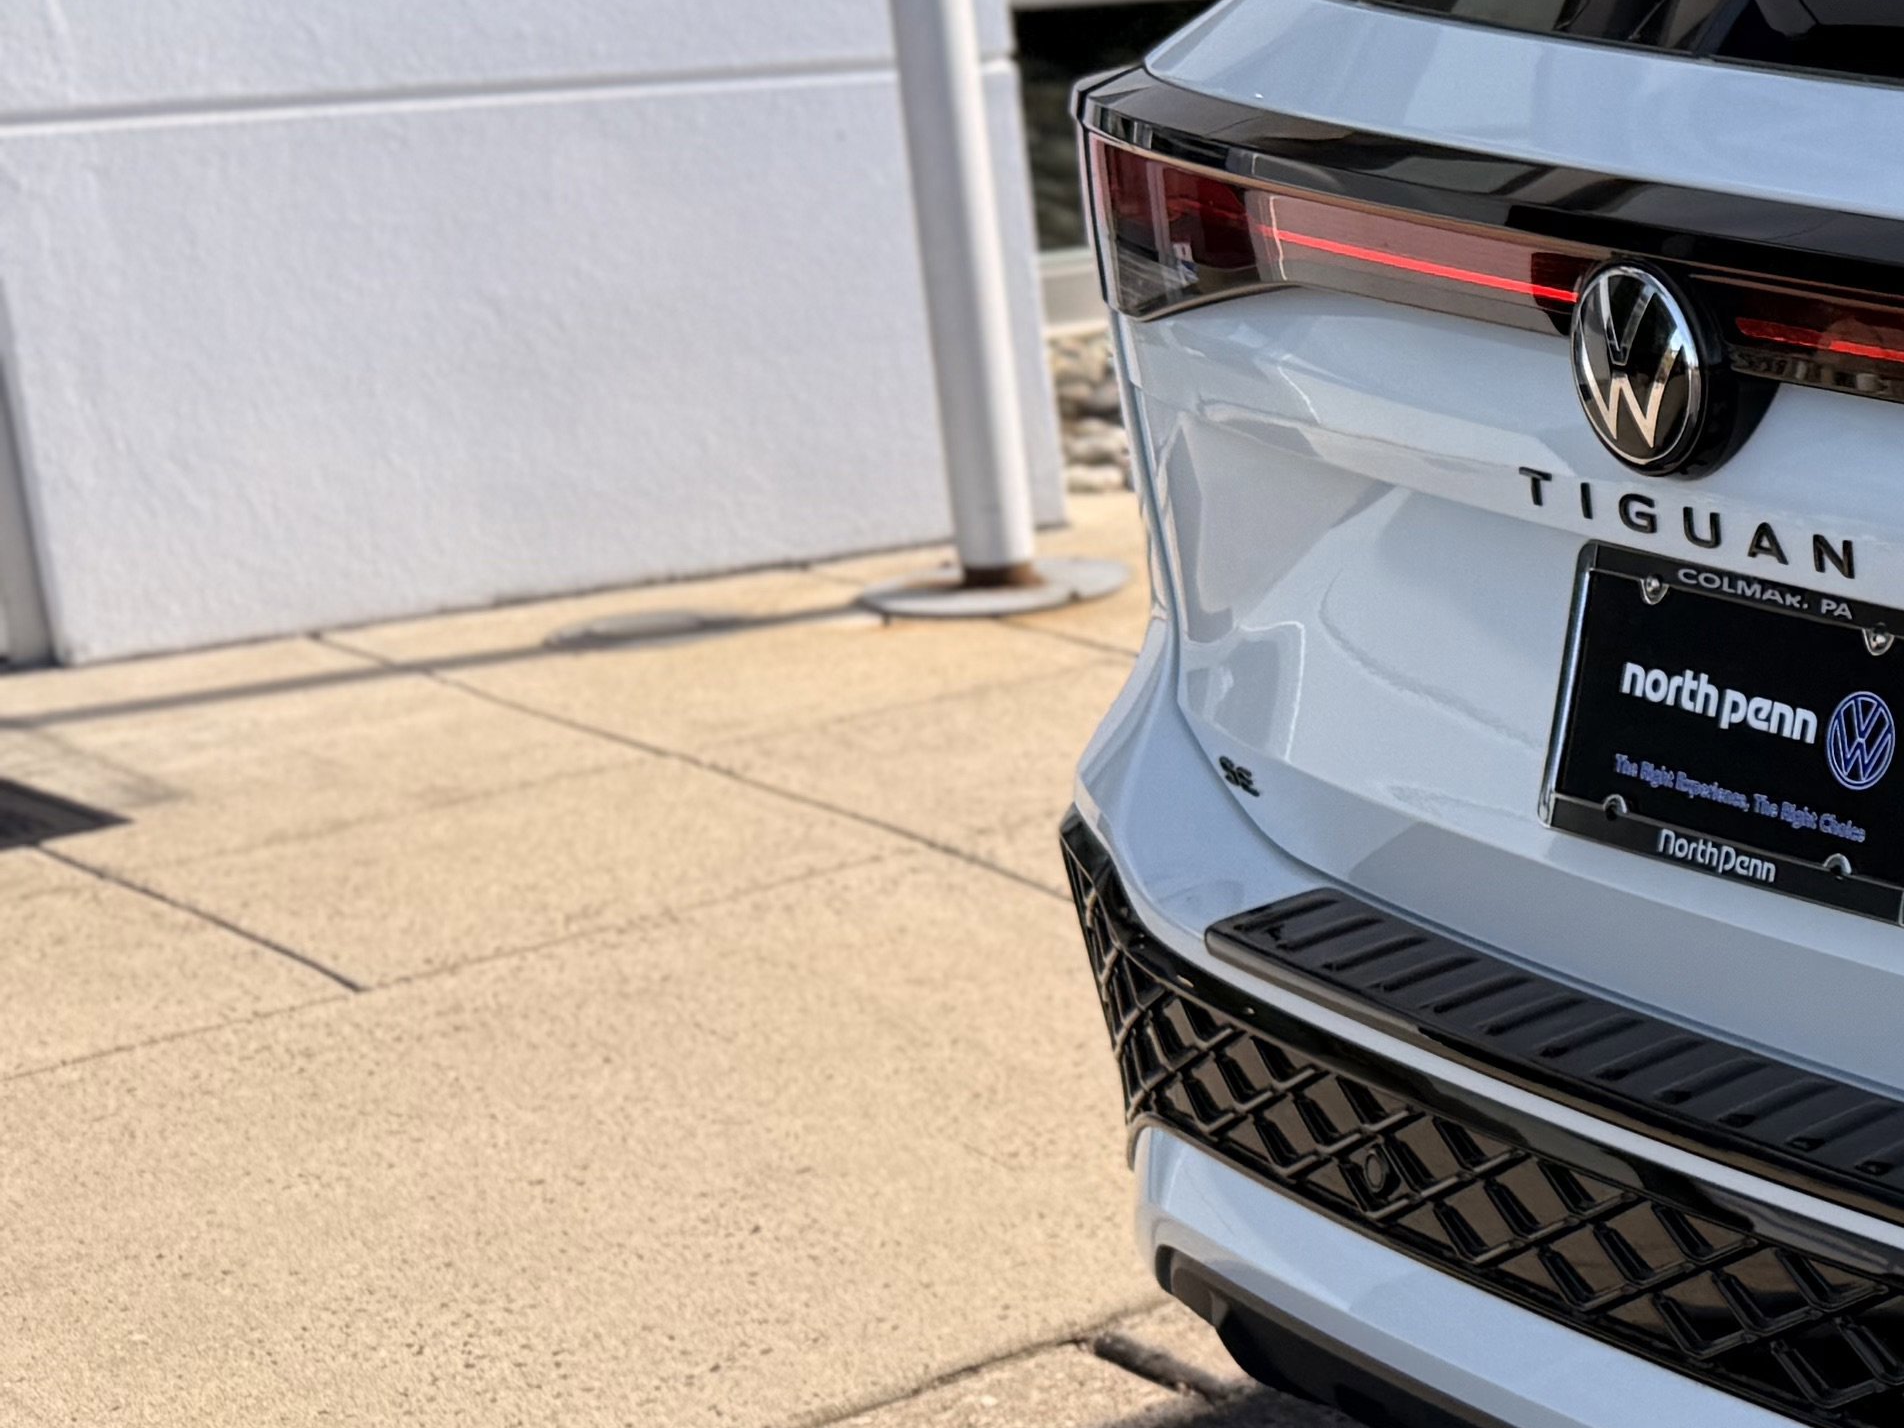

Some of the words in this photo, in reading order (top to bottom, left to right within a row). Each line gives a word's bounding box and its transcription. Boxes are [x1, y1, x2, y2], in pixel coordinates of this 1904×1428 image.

[1518, 465, 1856, 580] TIGUAN
[1820, 598, 1853, 621] PA
[1615, 753, 1639, 778] The
[1640, 760, 1675, 789] Right
[1675, 770, 1750, 812] Experience,
[1753, 793, 1779, 818] The
[1780, 801, 1818, 830] Right
[1819, 813, 1866, 843] Choice
